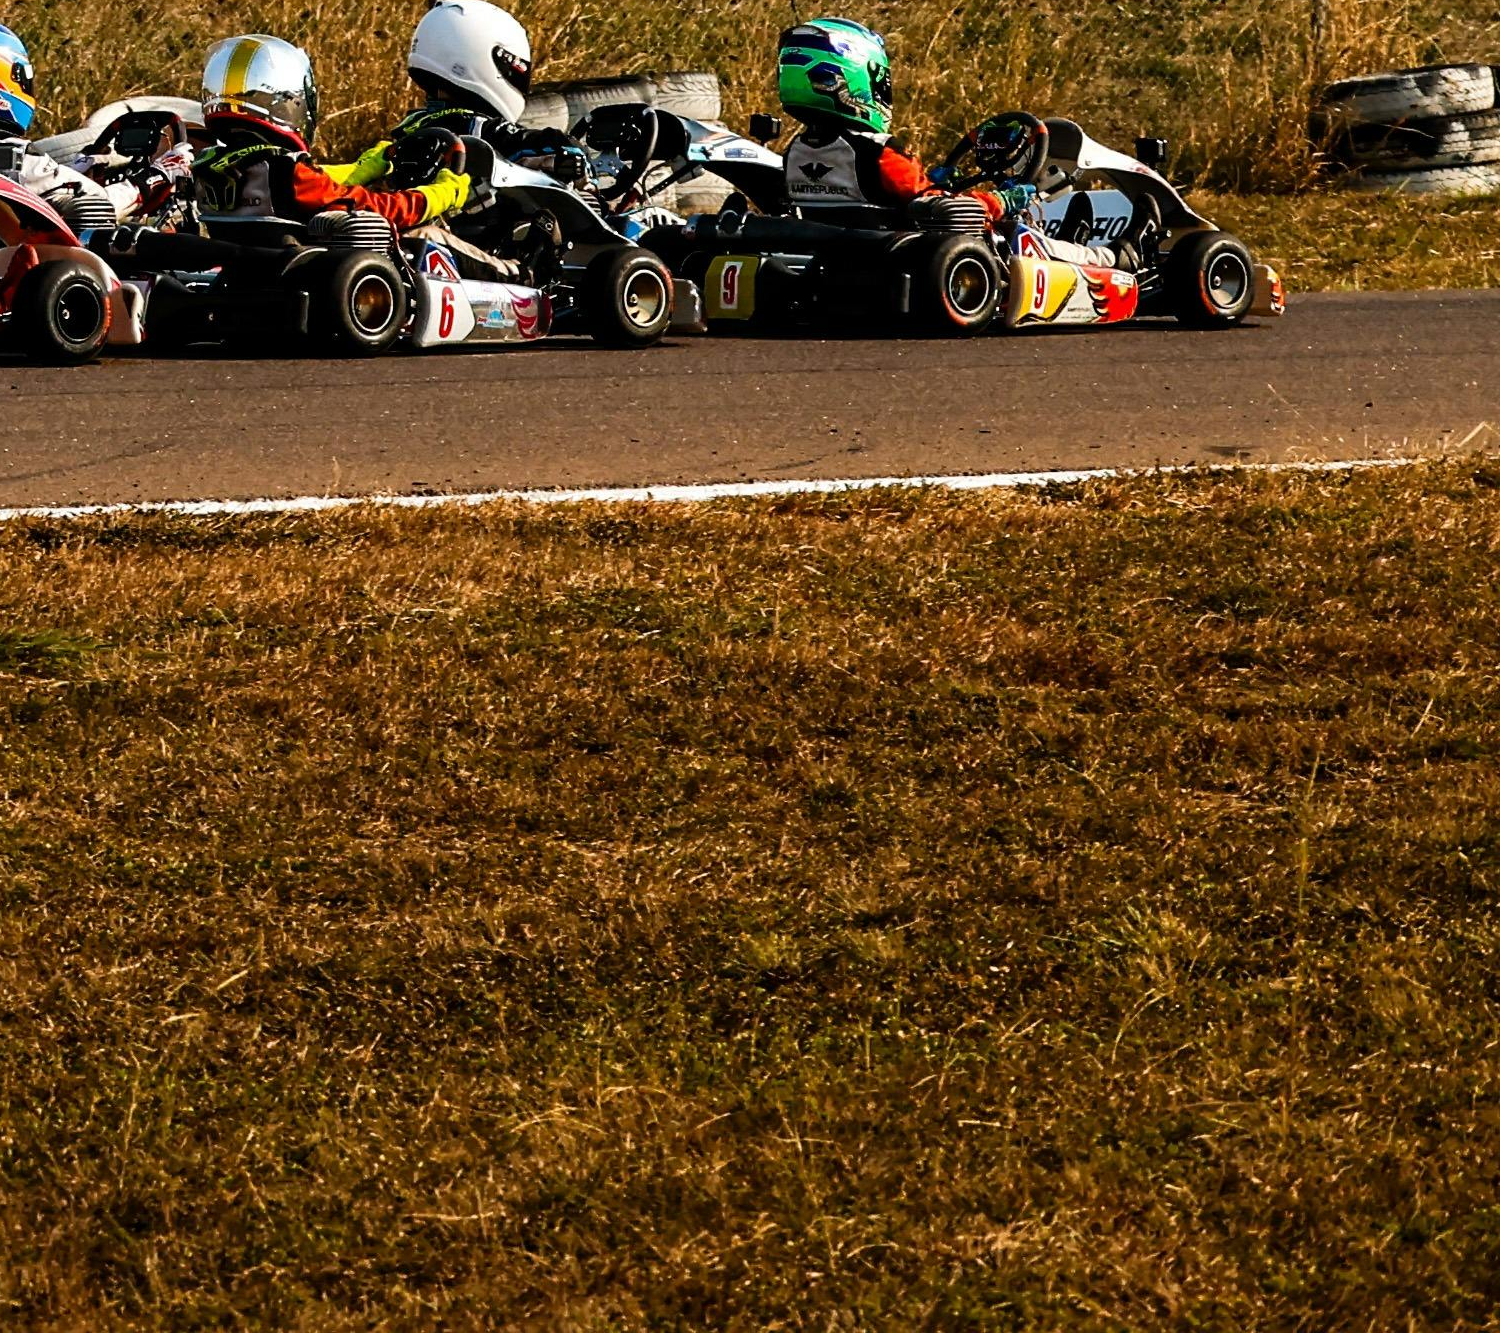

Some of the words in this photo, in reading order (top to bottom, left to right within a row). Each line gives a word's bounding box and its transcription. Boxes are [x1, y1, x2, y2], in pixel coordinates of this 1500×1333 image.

[722, 264, 738, 305] 9
[1034, 269, 1045, 310] 9
[438, 286, 455, 339] 6
